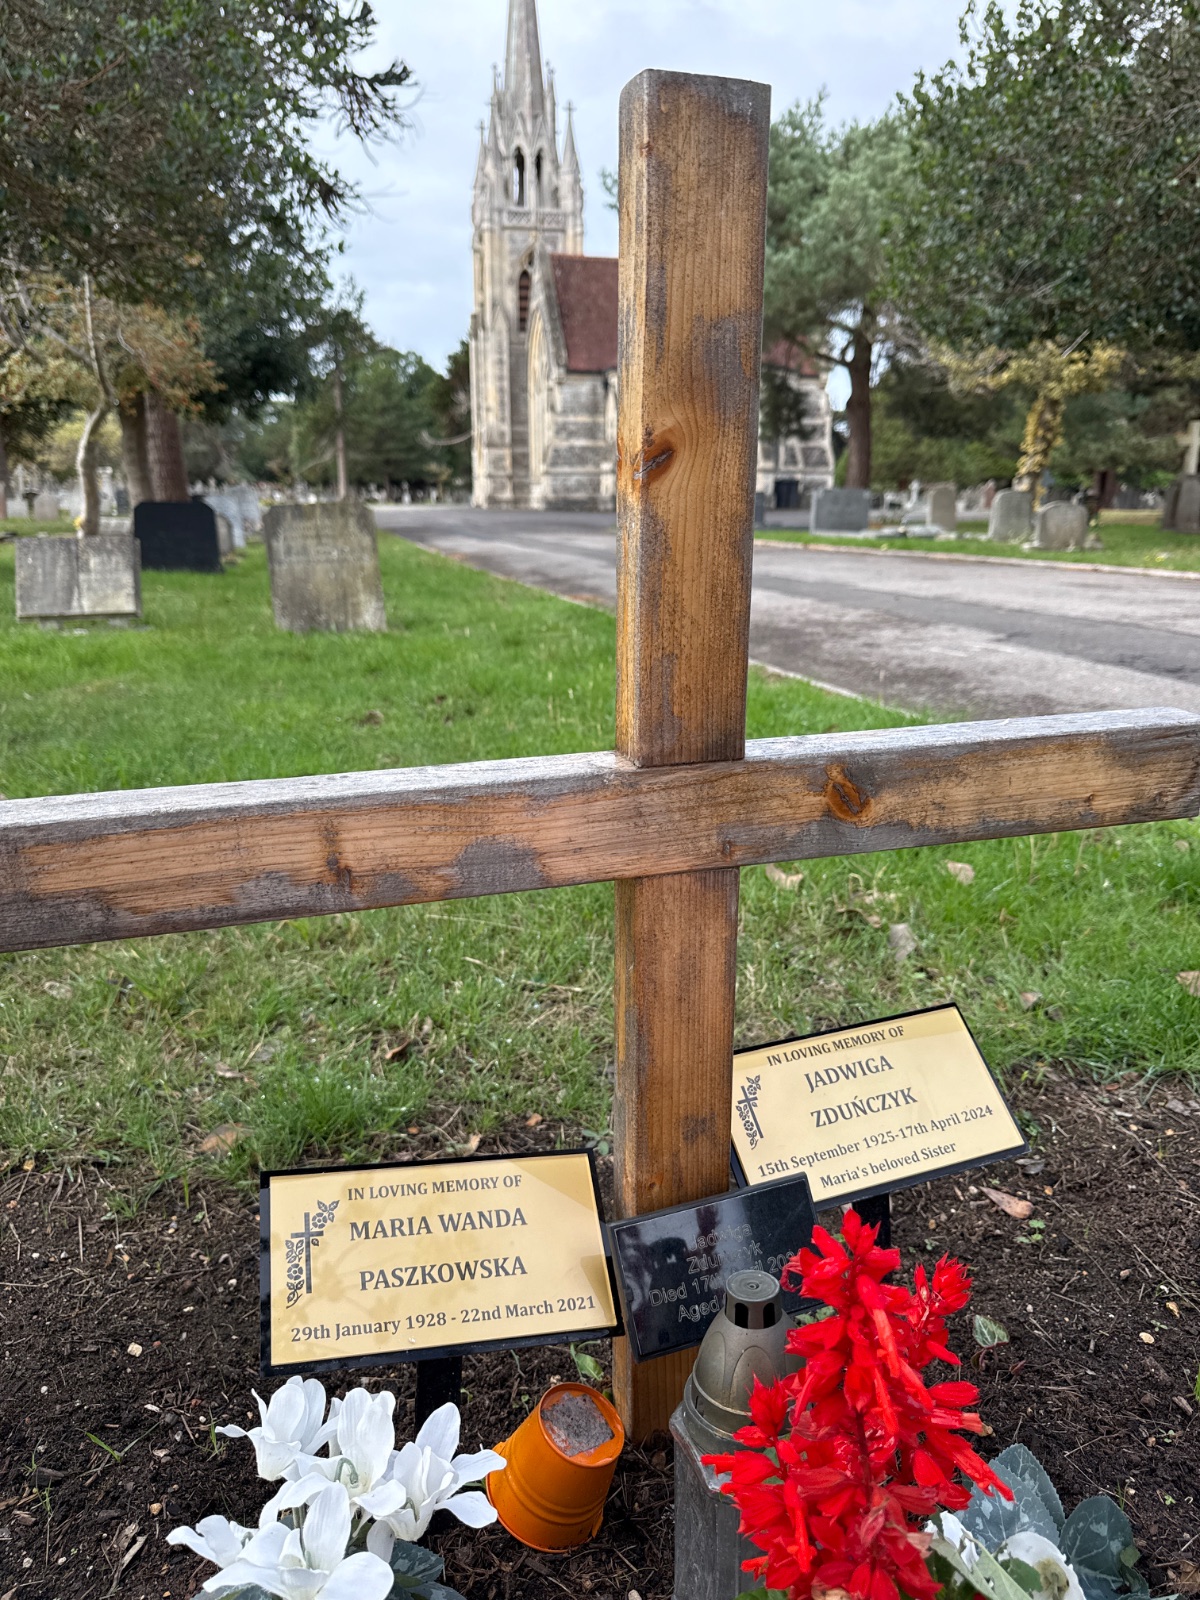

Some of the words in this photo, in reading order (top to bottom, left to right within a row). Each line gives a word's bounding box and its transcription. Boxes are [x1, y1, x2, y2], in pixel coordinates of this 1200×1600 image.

[767, 1055, 782, 1066] IN
[783, 1042, 831, 1063] LOVING
[833, 1030, 888, 1051] MEMORY
[889, 1026, 905, 1037] OF
[804, 1056, 894, 1093] JADWIGA
[811, 1088, 918, 1128] ZDUŃCZYK
[758, 1156, 790, 1177] 15th
[791, 1139, 861, 1170] September
[930, 1113, 961, 1132] April
[964, 1104, 993, 1123] 2024
[820, 1164, 868, 1188] Maria's
[871, 1151, 919, 1178] beloved
[921, 1143, 956, 1163] Sister
[347, 1187, 365, 1200] IN
[369, 1182, 428, 1199] LOVING
[432, 1177, 499, 1193] MEMORY
[503, 1175, 522, 1187] OF
[350, 1216, 432, 1241] MARIA
[438, 1207, 528, 1233] WANDA
[359, 1256, 528, 1291] PASZKOWSKA
[686, 1240, 763, 1274] Zduzyk
[648, 1282, 687, 1307] Died
[678, 1295, 720, 1322] Aged
[291, 1325, 331, 1342] 29th
[335, 1318, 400, 1340] January
[406, 1312, 447, 1329] 1928
[460, 1306, 502, 1323] 22nd
[505, 1300, 554, 1318] March
[557, 1295, 596, 1312] 2021
